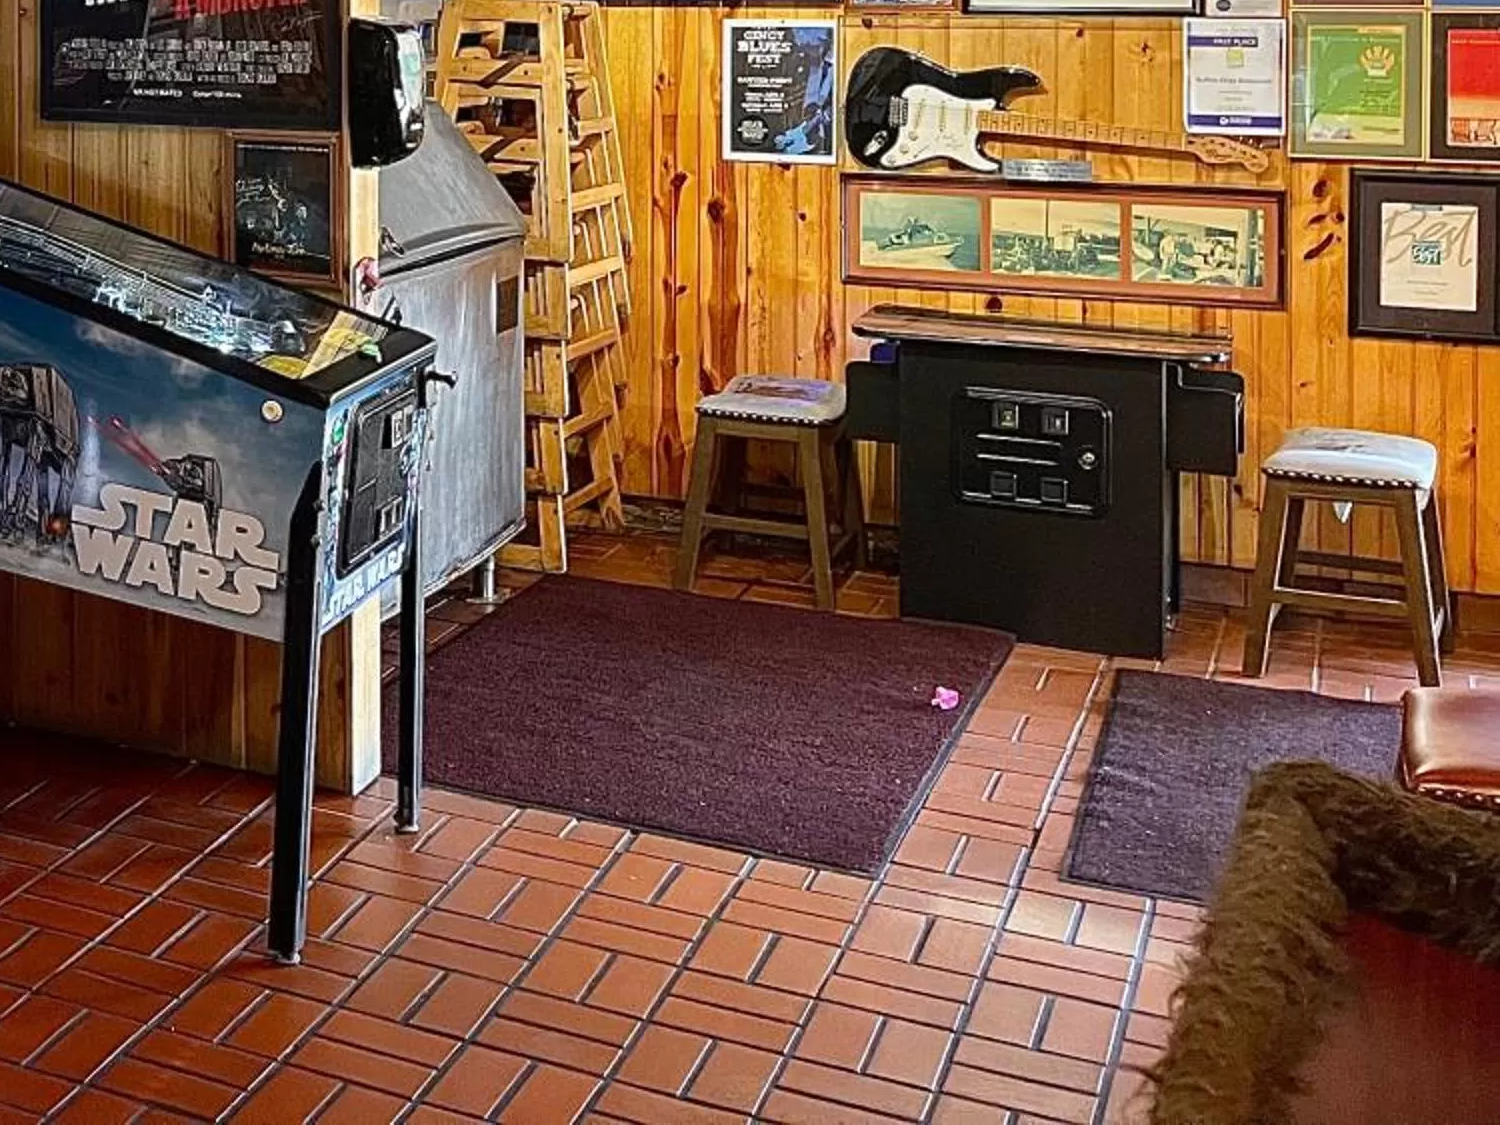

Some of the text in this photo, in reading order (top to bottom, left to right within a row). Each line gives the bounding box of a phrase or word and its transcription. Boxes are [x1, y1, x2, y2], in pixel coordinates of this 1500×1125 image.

[736, 40, 793, 53] BLUES
[747, 54, 782, 64] FEST
[71, 481, 281, 572] STAR
[71, 523, 278, 616] WARS
